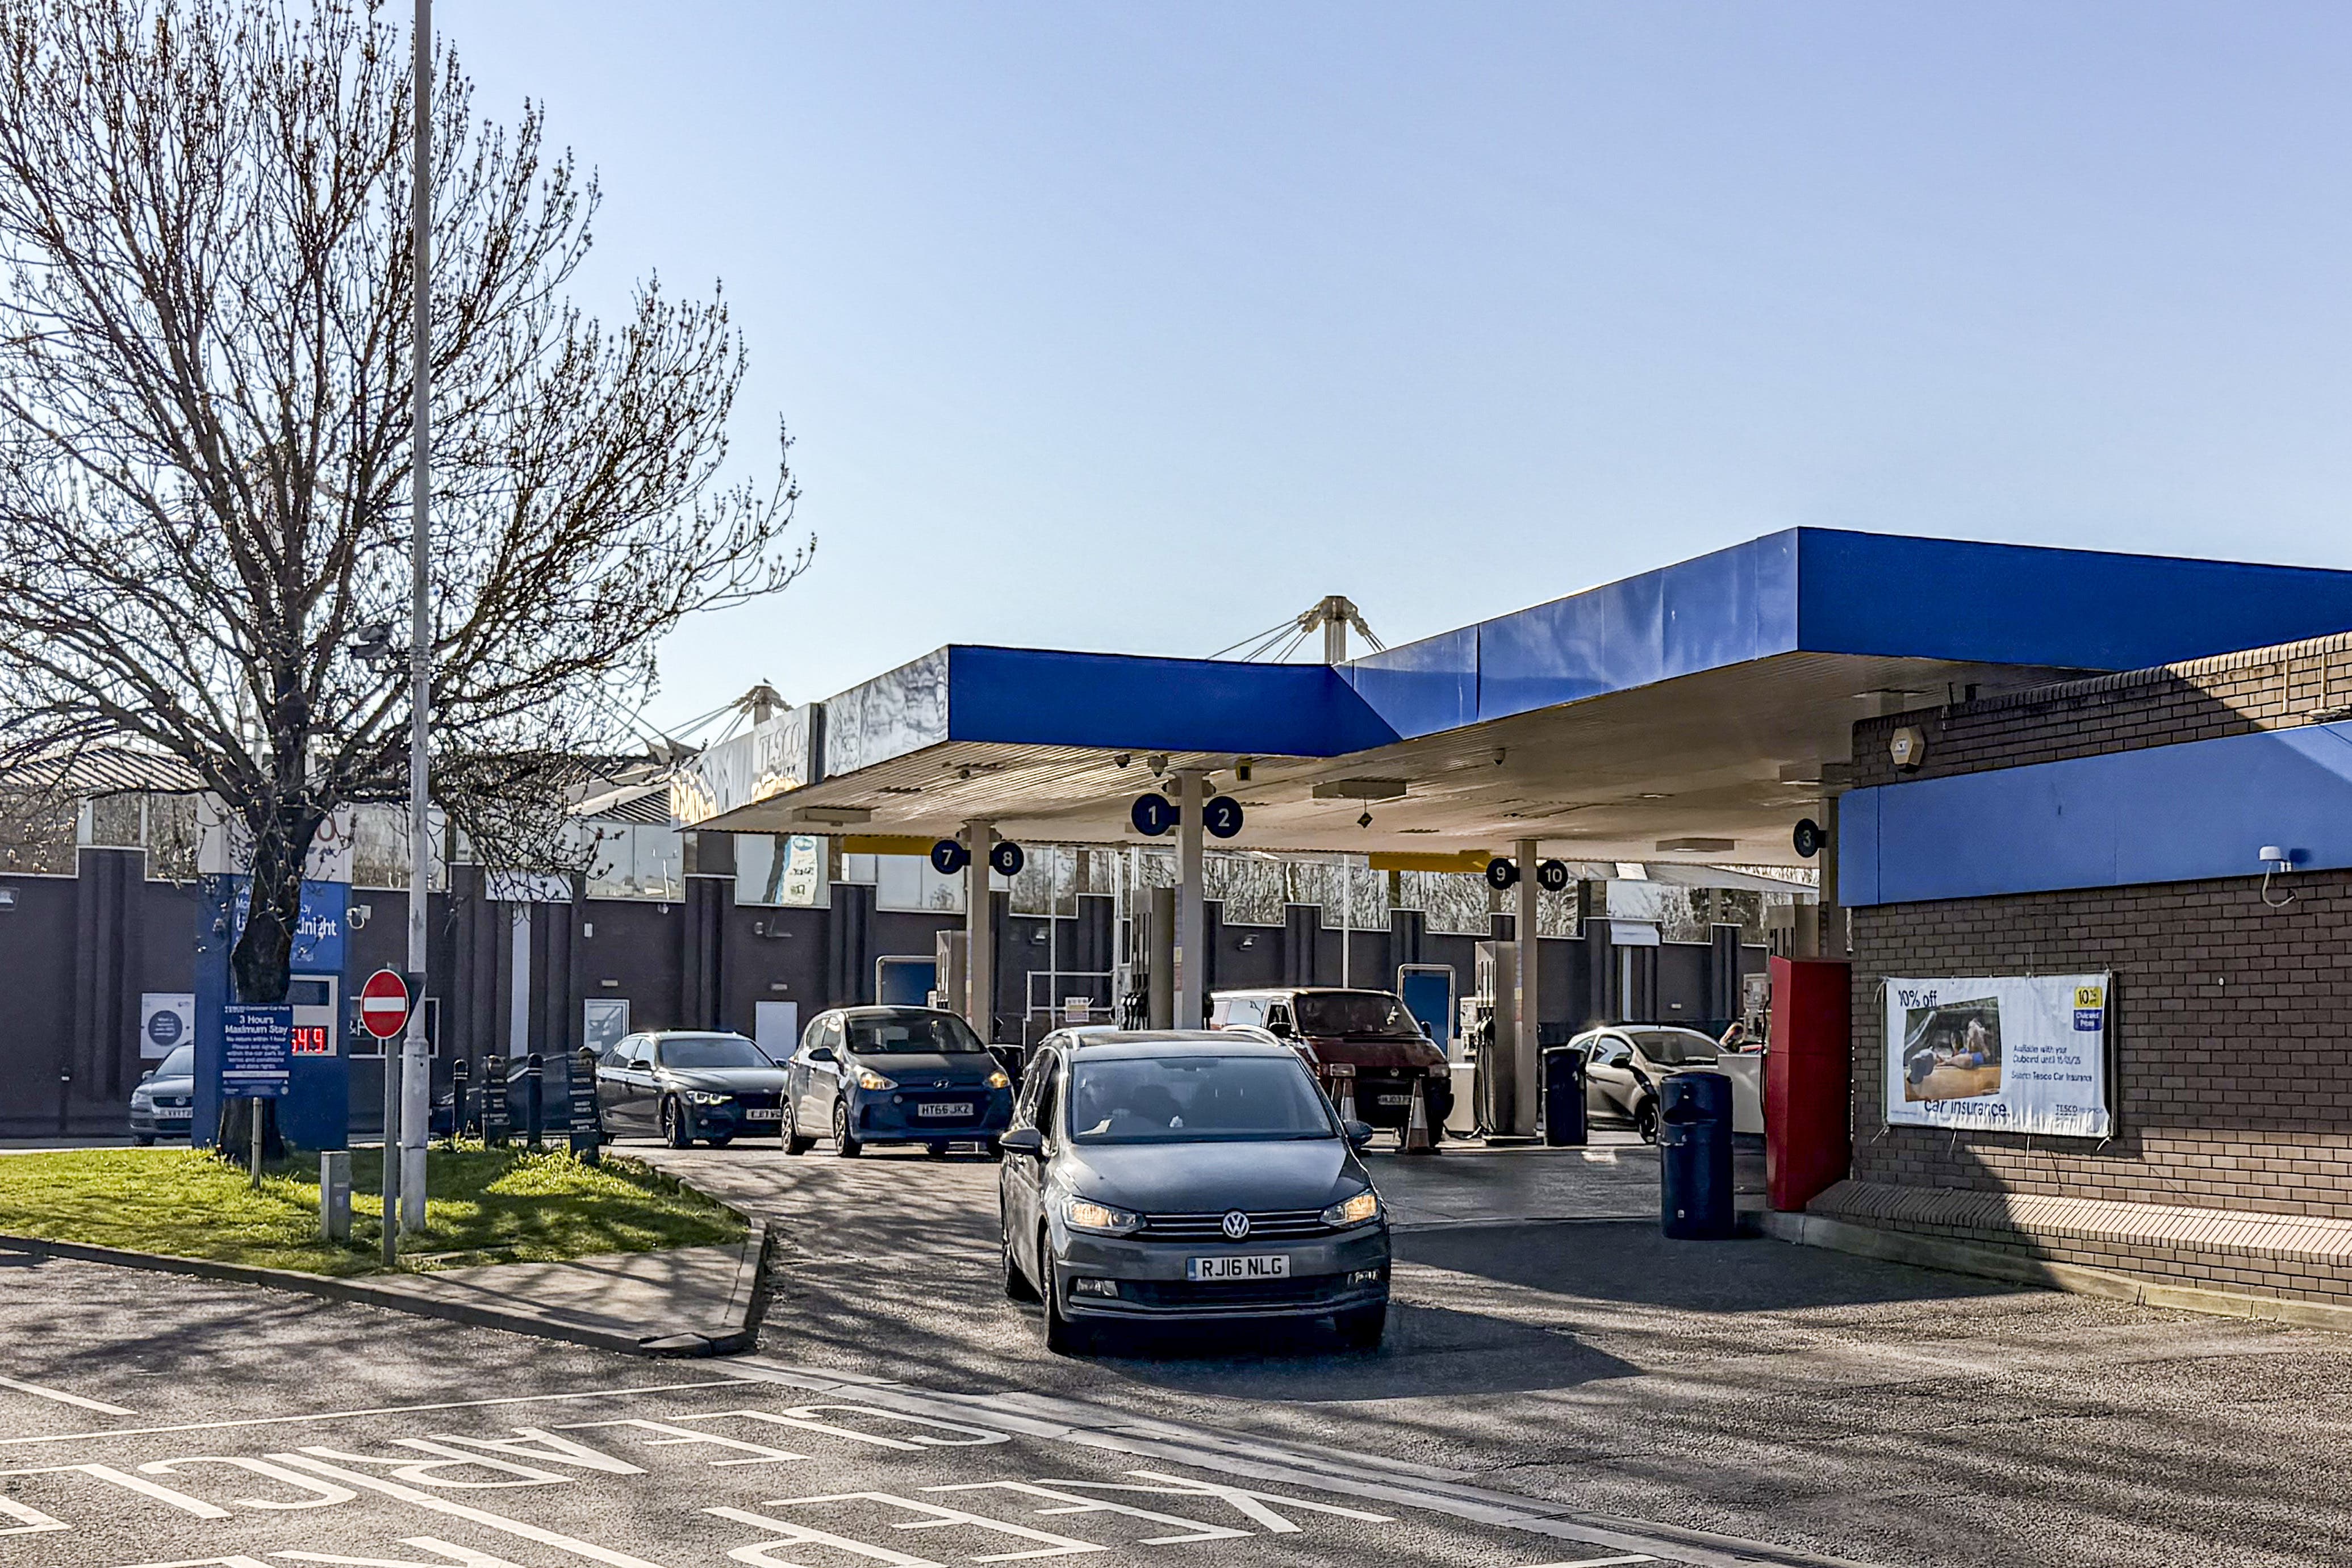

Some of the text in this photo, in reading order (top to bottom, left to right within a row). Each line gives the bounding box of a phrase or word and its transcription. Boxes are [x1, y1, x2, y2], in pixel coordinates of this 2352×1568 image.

[1148, 805, 1156, 825] 1
[1218, 808, 1230, 827] 2
[1803, 830, 1811, 847] 3
[943, 849, 953, 865] 7
[1002, 851, 1013, 866] 8
[1496, 867, 1506, 881] 9
[1545, 868, 1562, 883] 10
[1898, 990, 1937, 1008] 10% off
[239, 1015, 274, 1024] 3 Hours
[225, 1025, 289, 1035] Maximum Stay
[2033, 1071, 2052, 1080] Tesco
[2053, 1072, 2065, 1081] Car
[1924, 1098, 1948, 1114] car
[1202, 1257, 1282, 1277] RJ16 NLG
